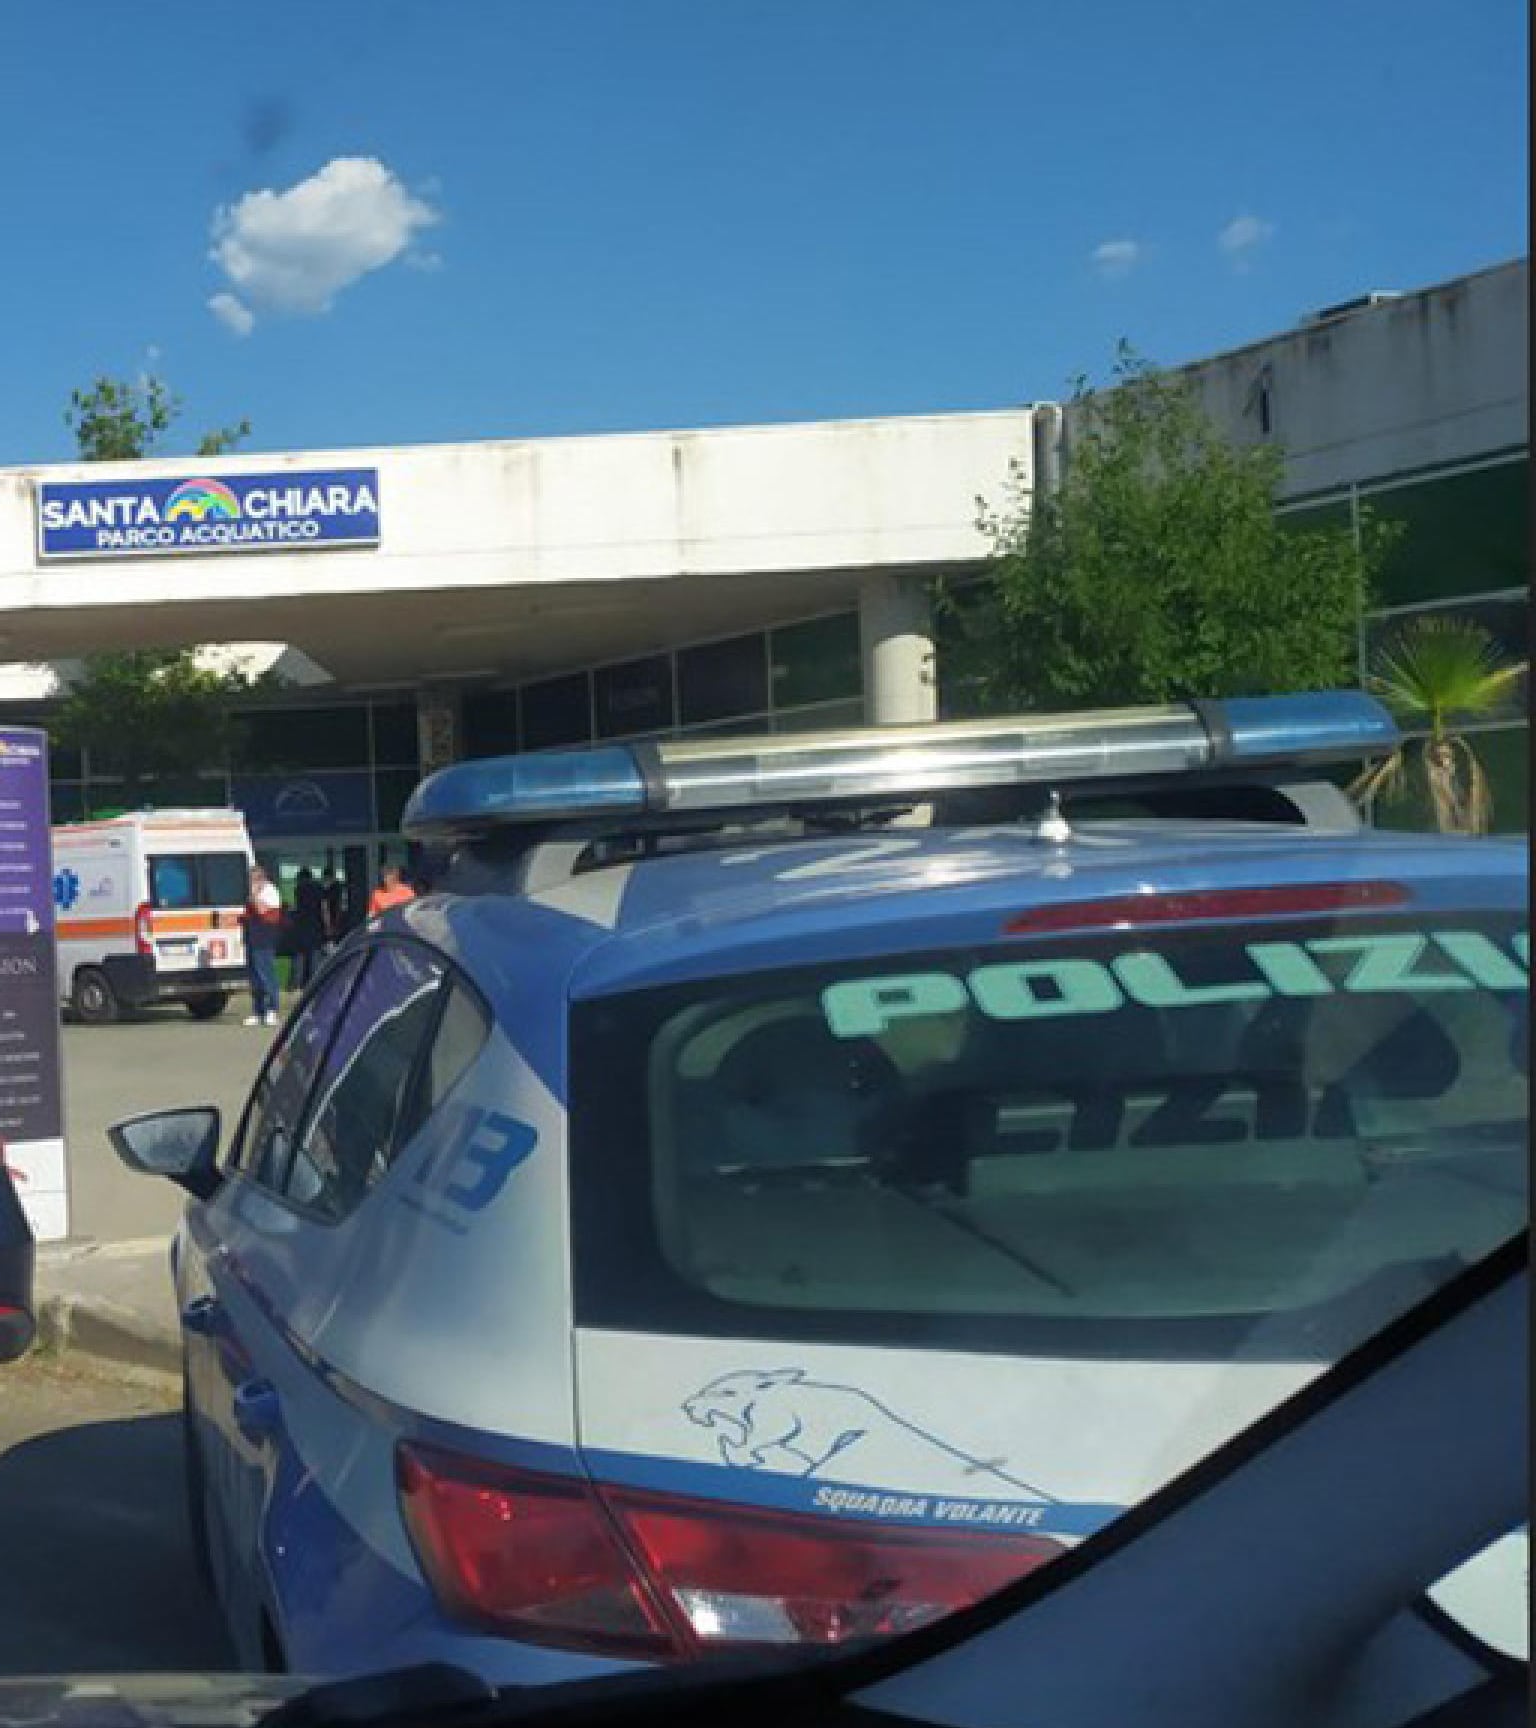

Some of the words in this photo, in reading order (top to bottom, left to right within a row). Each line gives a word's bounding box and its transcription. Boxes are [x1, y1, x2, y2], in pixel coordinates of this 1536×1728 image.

[42, 496, 161, 529] SANTA
[245, 484, 377, 519] CHIARA
[97, 526, 175, 548] PARCO
[181, 520, 320, 545] ACQUATICO
[821, 931, 1530, 1038] POLIZI
[814, 1486, 928, 1518] SQUADRA
[933, 1501, 1046, 1528] VOLANTE
